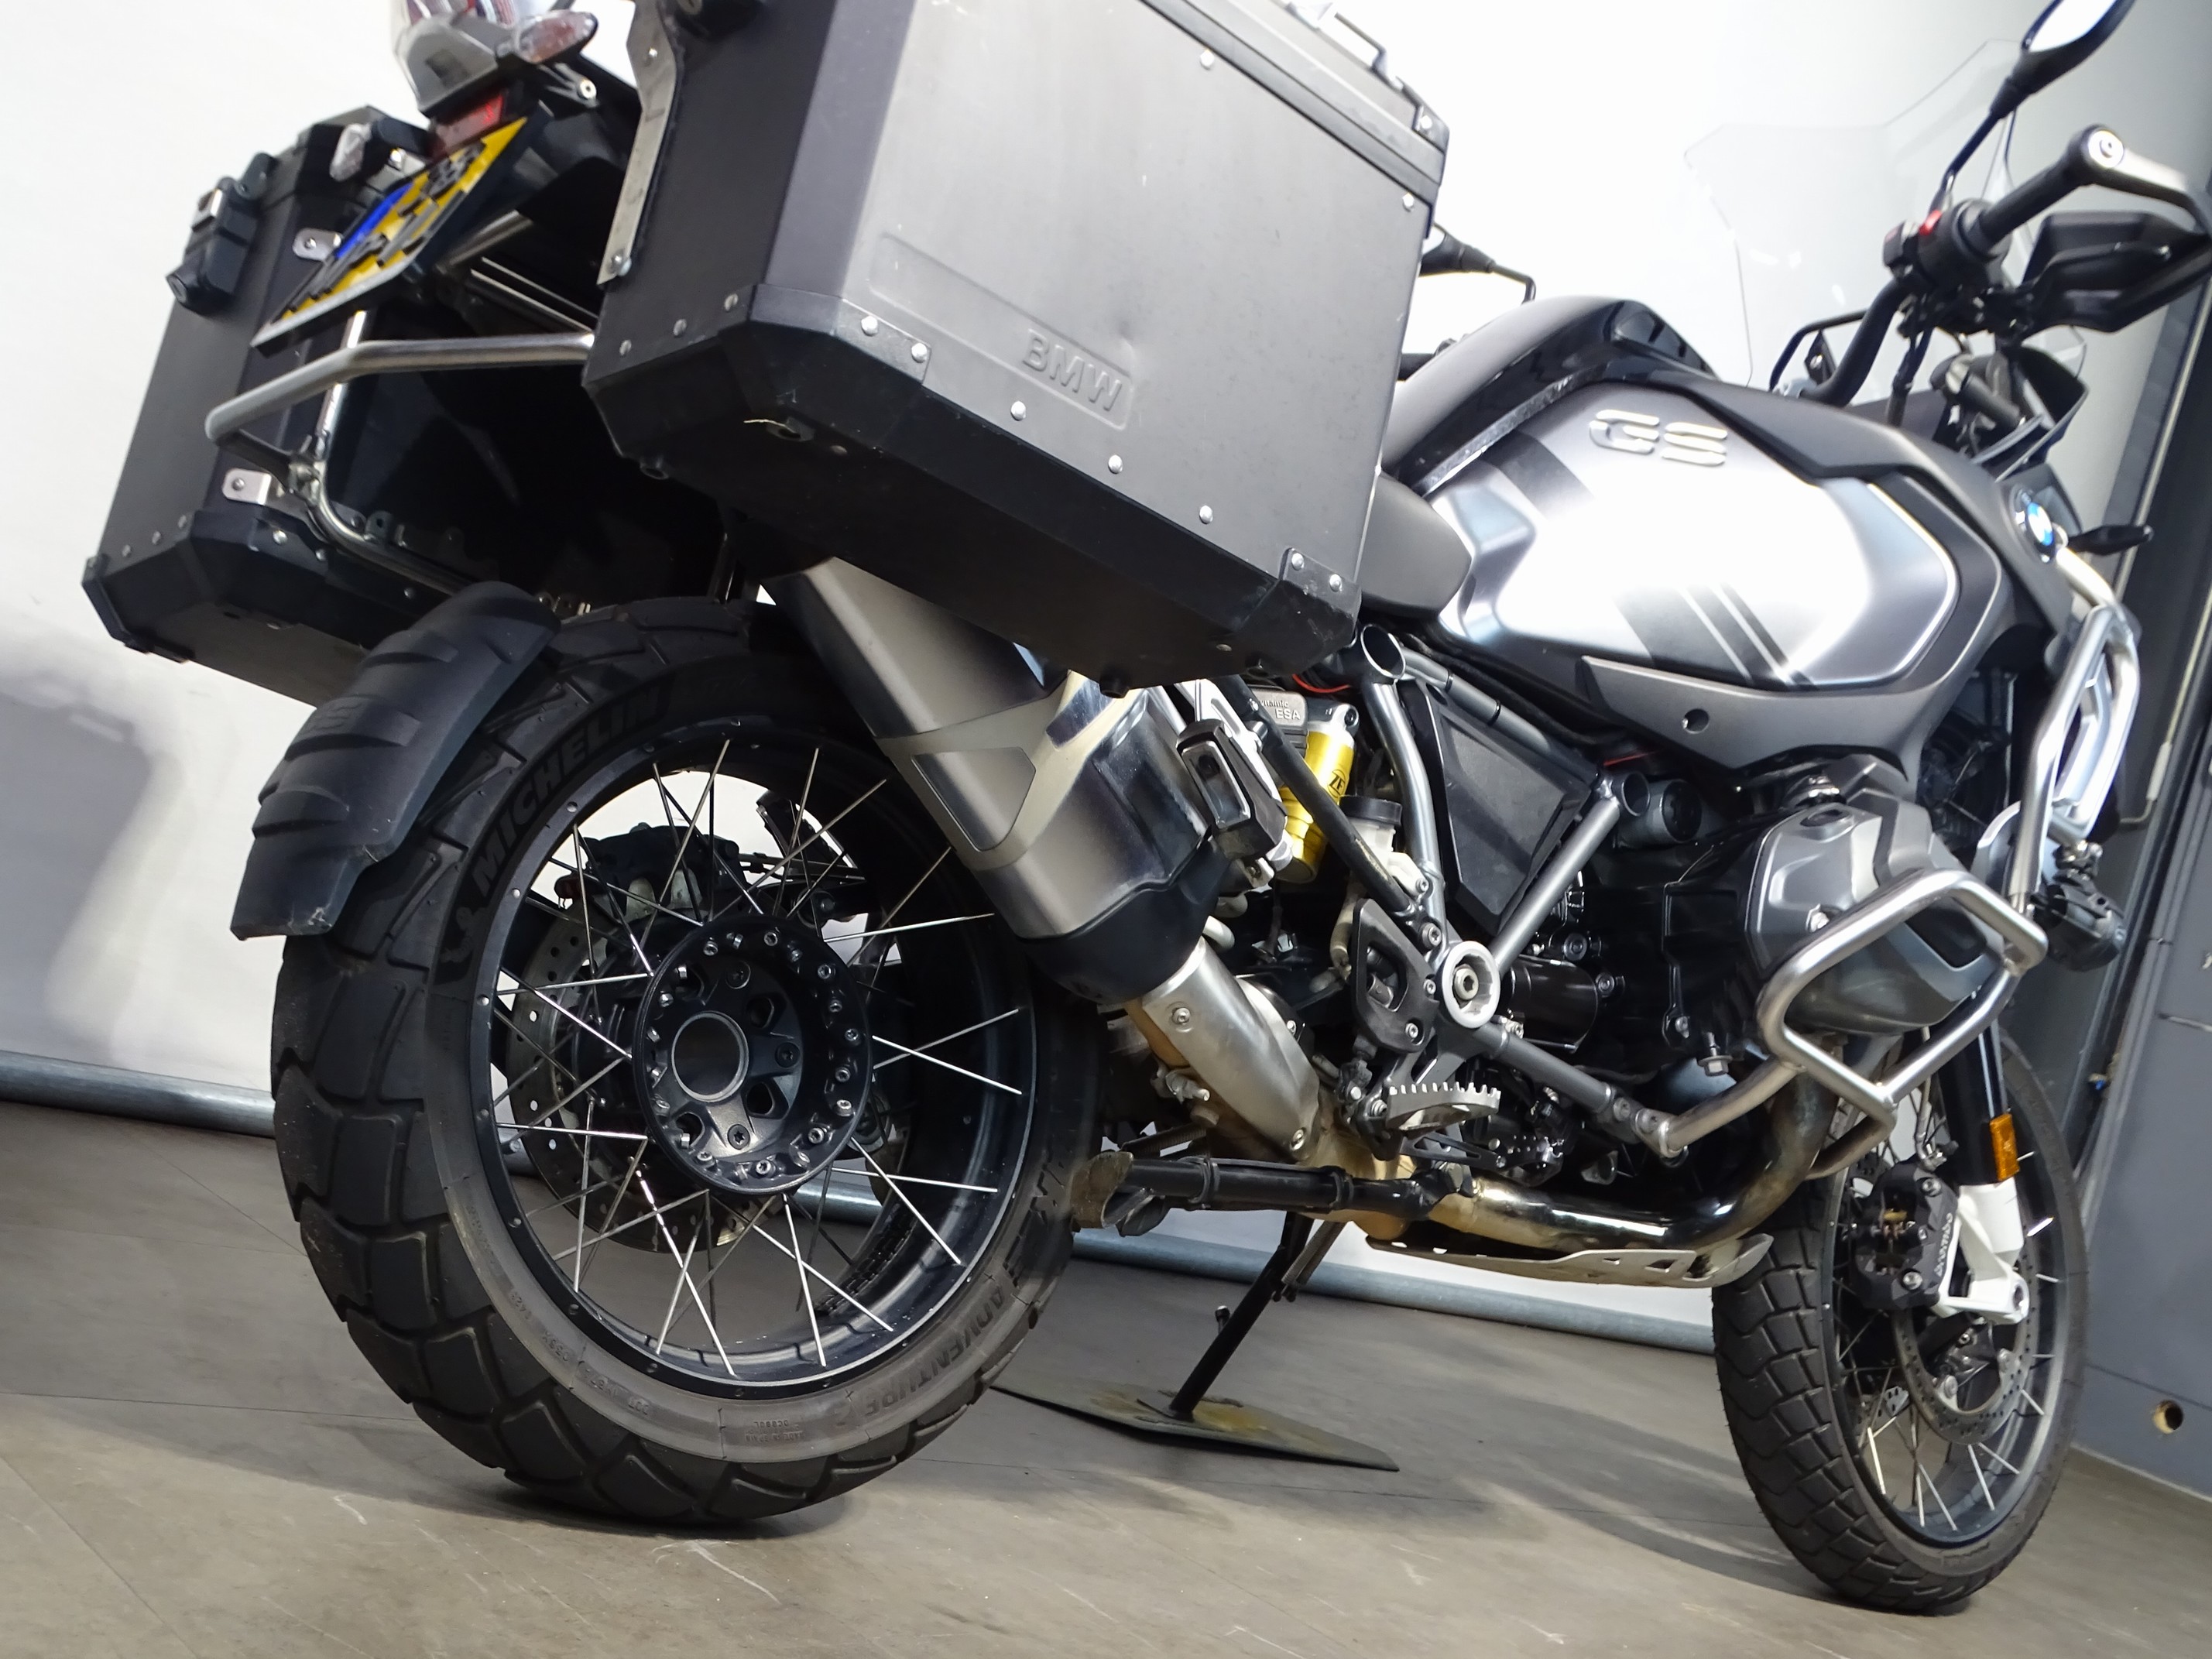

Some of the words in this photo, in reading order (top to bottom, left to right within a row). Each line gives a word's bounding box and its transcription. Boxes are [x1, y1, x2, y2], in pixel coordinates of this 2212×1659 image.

[1021, 327, 1123, 413] BMW
[1588, 408, 1729, 468] GS
[1275, 708, 1301, 721] ESA
[471, 683, 664, 897] MICHELIN
[1328, 772, 1346, 796] ZF
